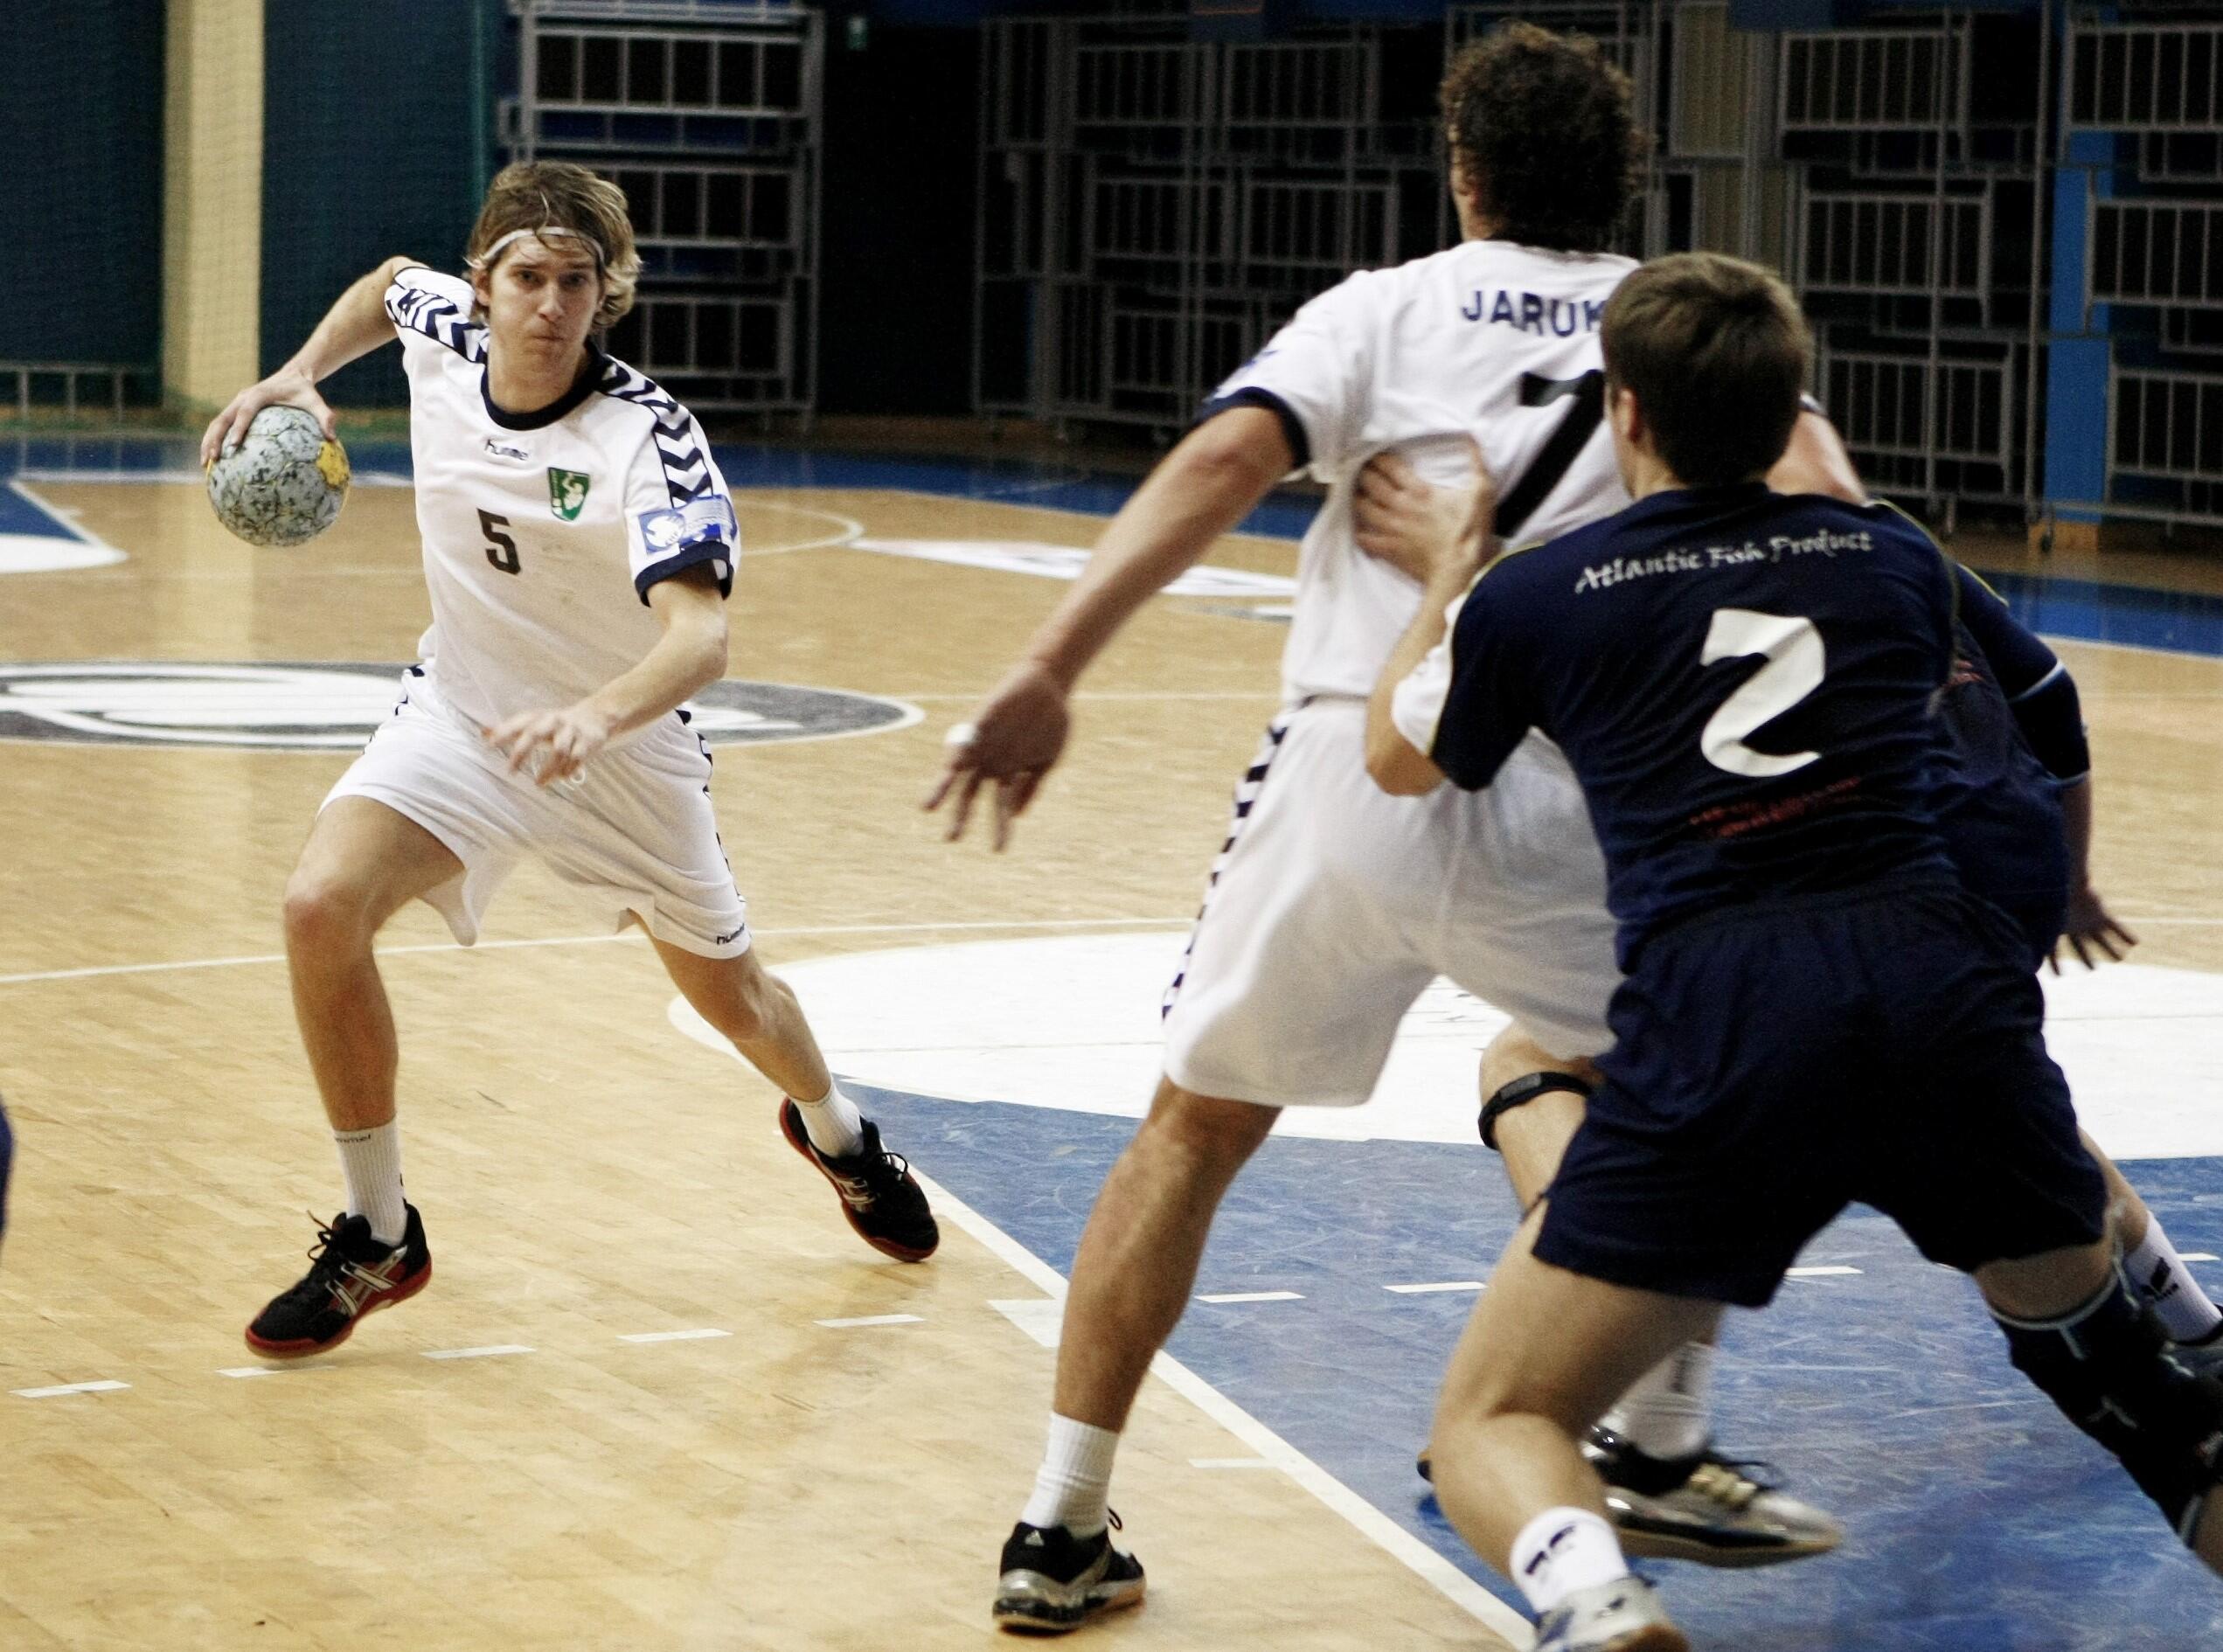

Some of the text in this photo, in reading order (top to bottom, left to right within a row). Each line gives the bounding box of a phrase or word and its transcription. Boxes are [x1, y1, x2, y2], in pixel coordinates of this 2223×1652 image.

[1493, 368, 1607, 538] 7
[476, 508, 522, 575] 5
[1575, 528, 1873, 594] Atlantic Fish Product
[1699, 607, 1826, 777] 2
